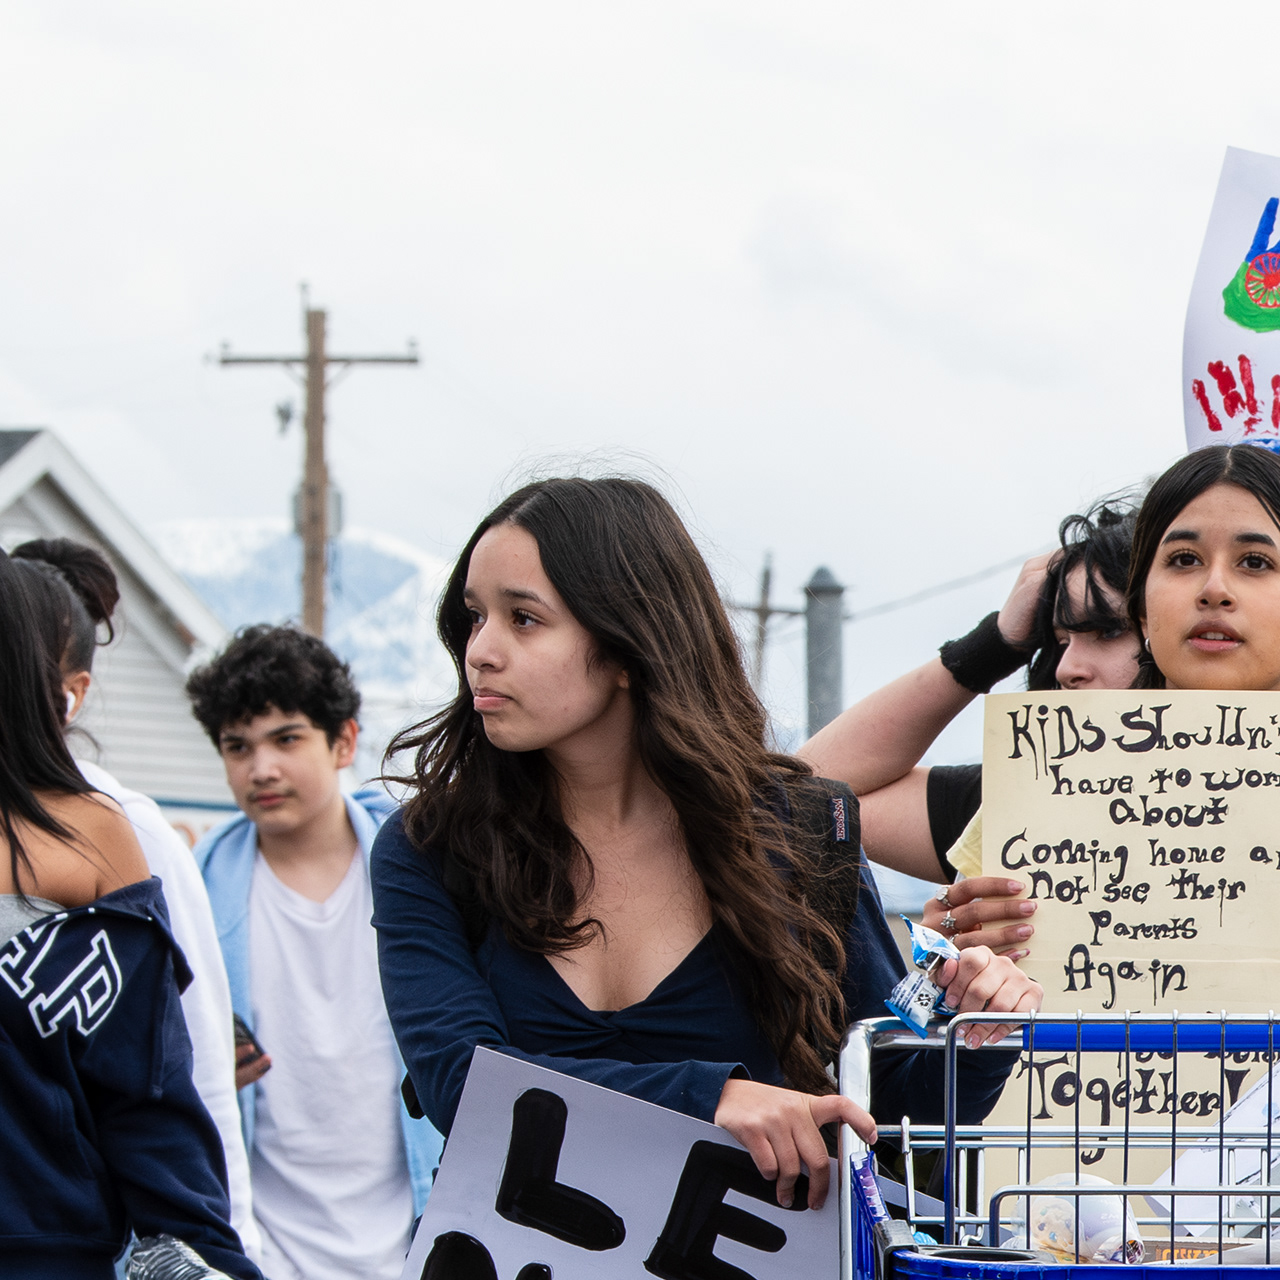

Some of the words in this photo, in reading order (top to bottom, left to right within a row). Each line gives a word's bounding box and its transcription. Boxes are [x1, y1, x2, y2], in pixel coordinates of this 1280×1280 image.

[1049, 764, 1134, 797] have
[1149, 767, 1192, 795] to
[1001, 828, 1130, 892] Coming
[1148, 838, 1227, 867] home
[1101, 879, 1151, 904] see
[1063, 943, 1189, 1010] Again
